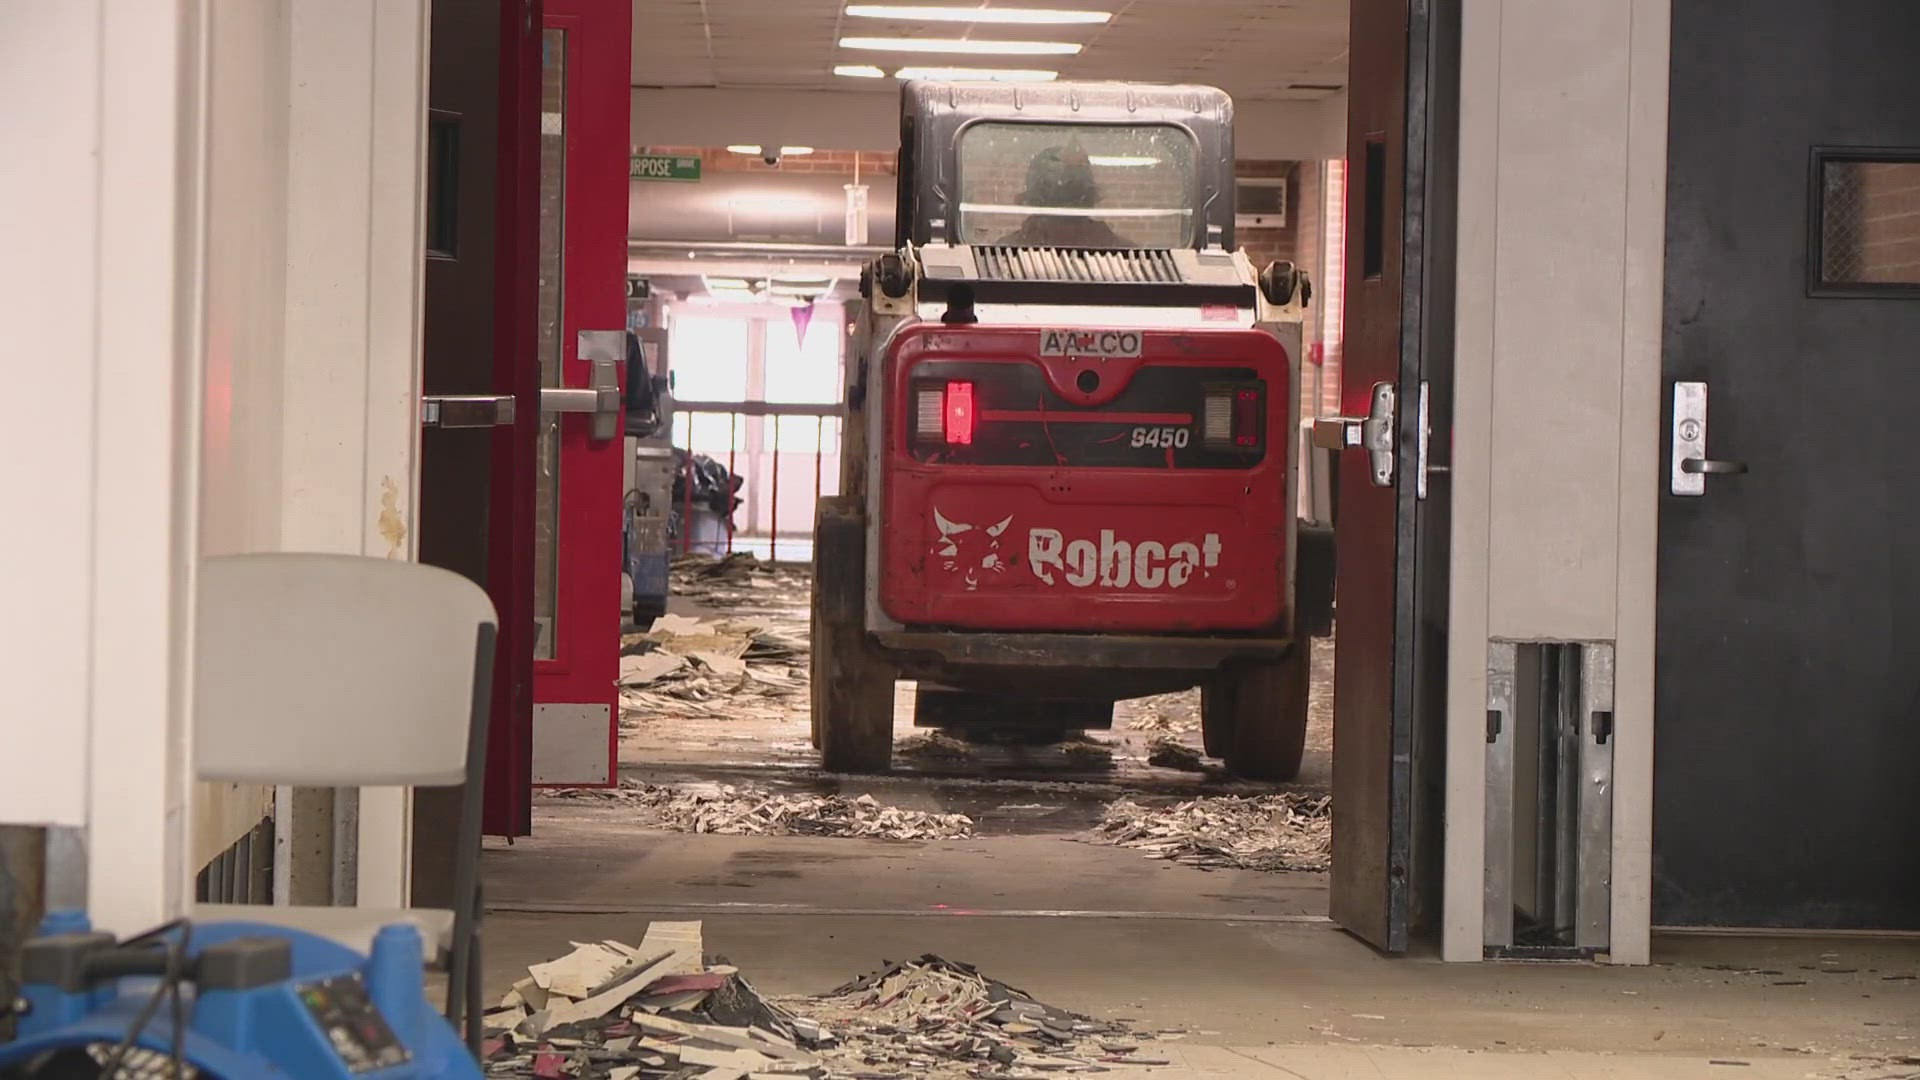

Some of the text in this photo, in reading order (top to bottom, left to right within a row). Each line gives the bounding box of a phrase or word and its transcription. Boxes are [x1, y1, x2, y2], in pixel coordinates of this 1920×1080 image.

[1044, 332, 1138, 354] AALCO
[1131, 427, 1189, 448] S450
[1028, 528, 1222, 588] Bobcat
